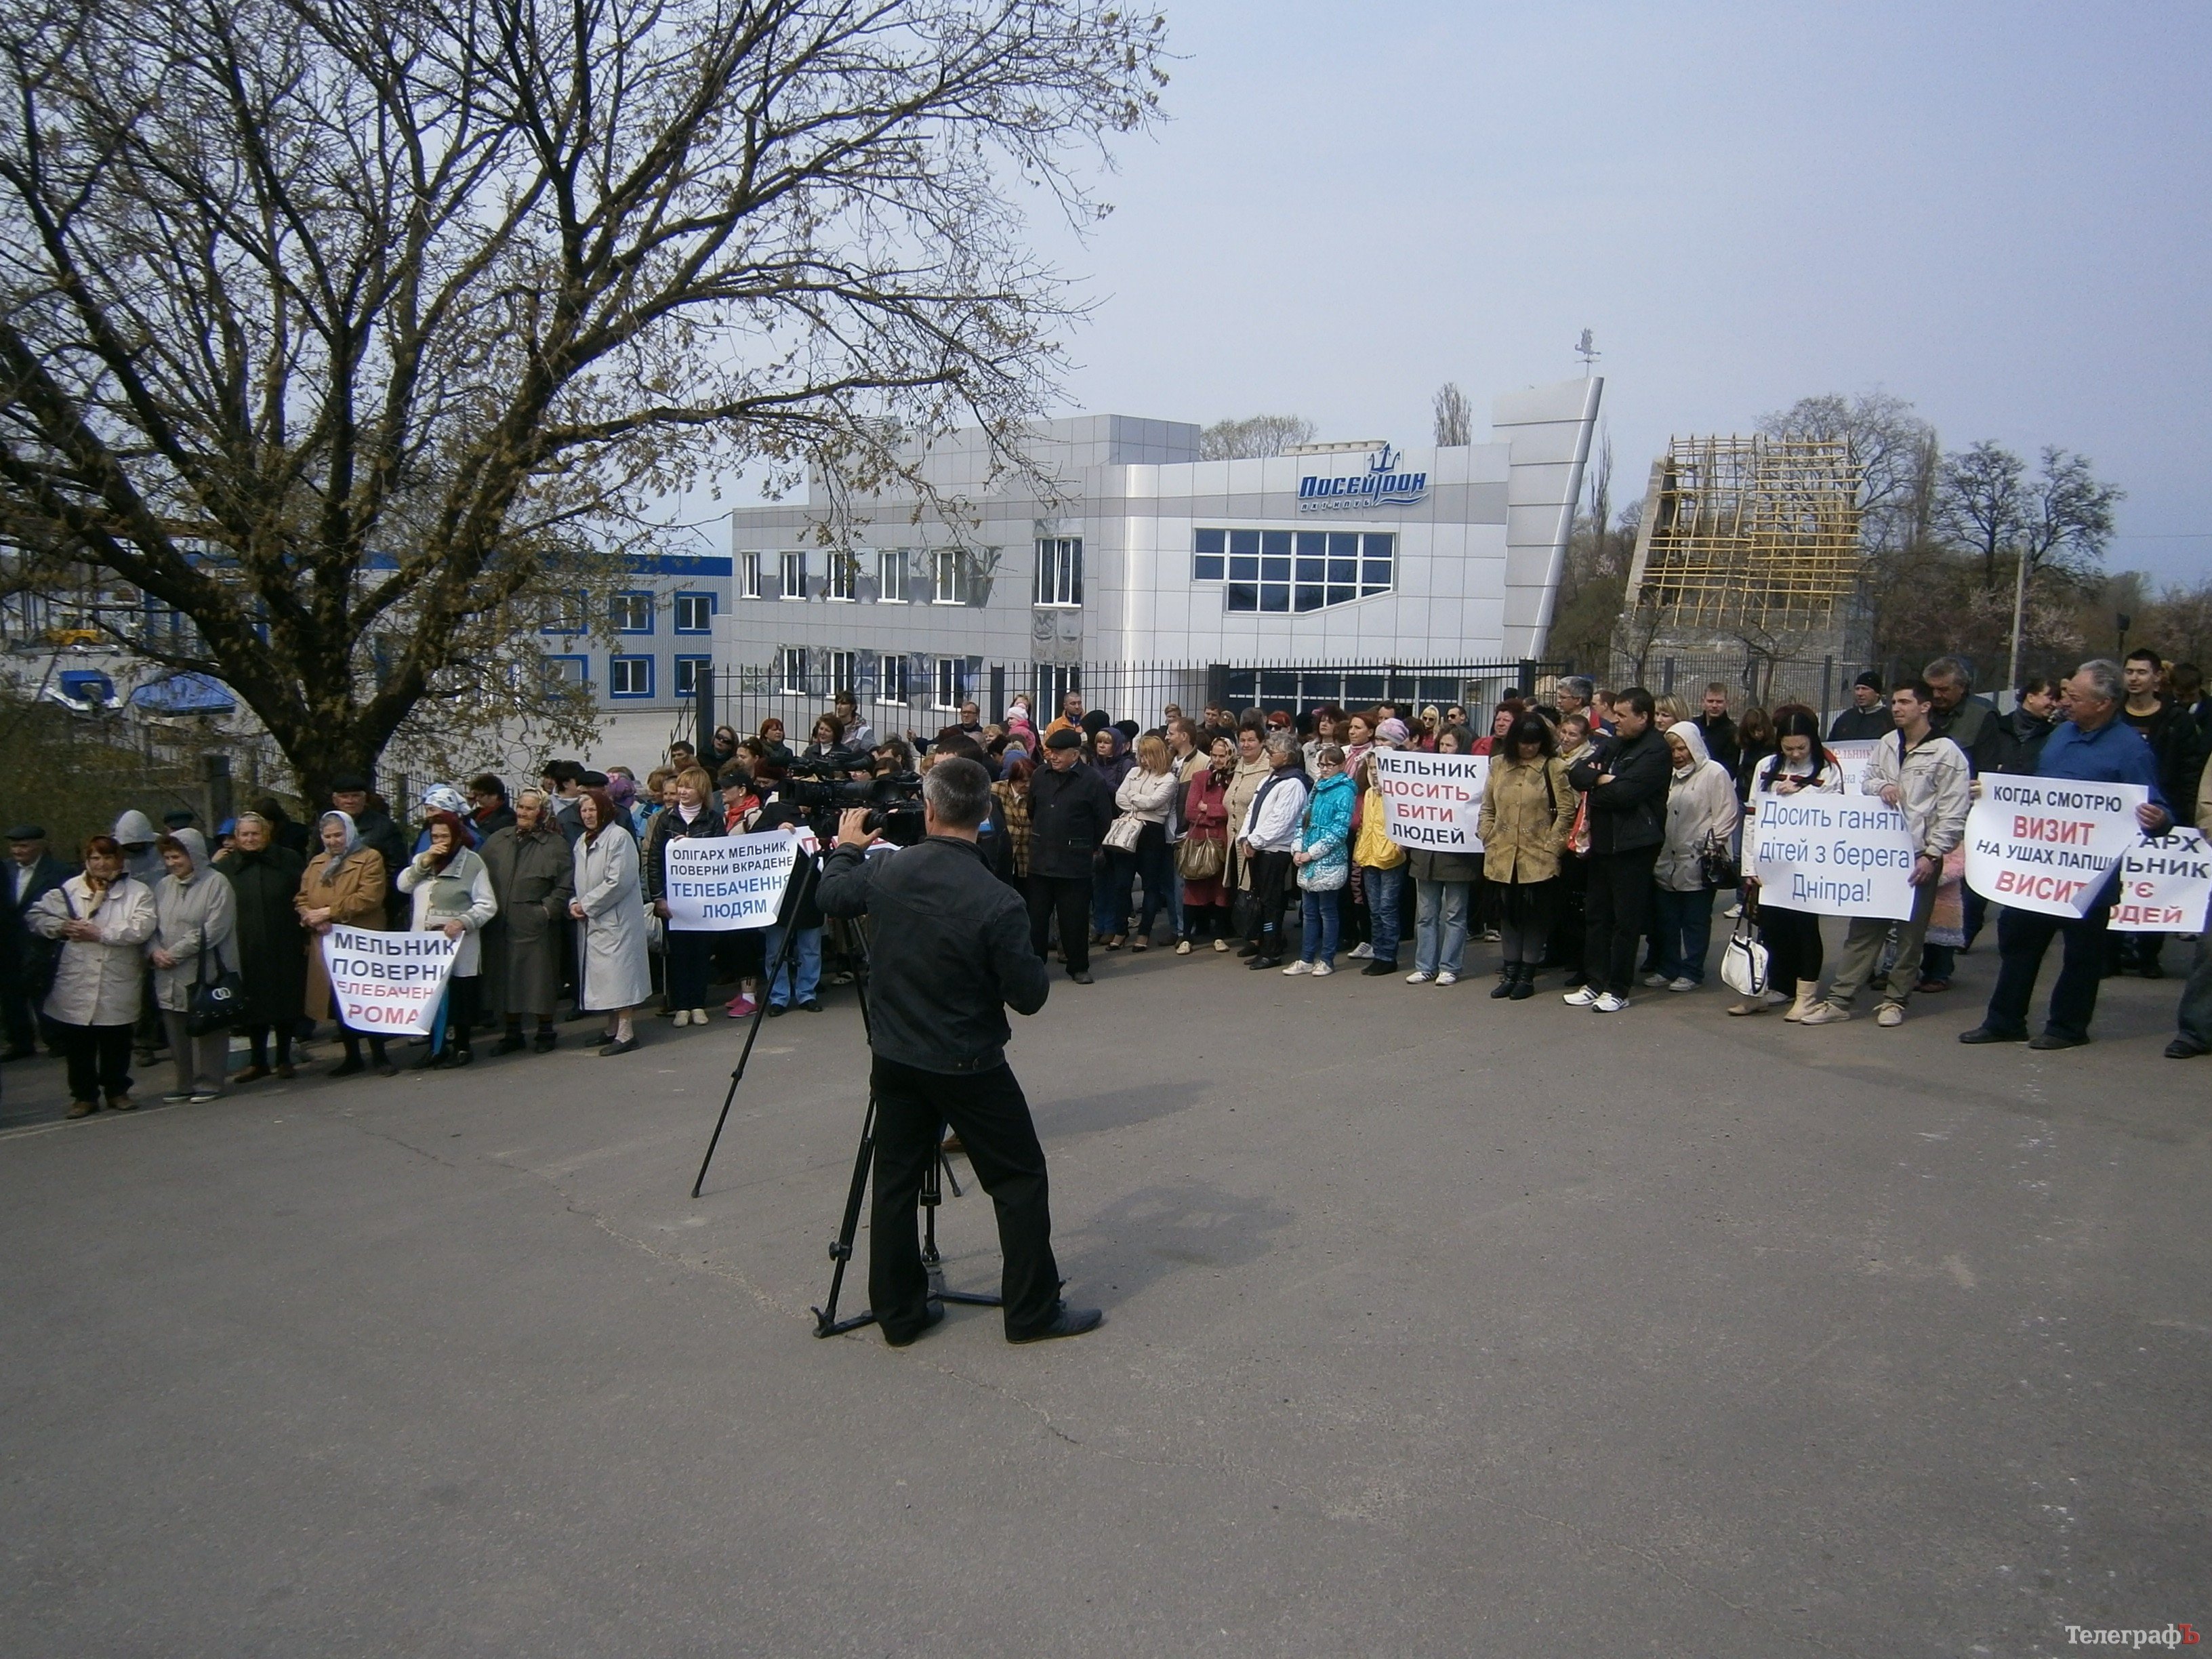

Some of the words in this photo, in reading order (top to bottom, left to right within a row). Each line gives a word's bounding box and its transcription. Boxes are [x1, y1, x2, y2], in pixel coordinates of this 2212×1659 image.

[1377, 757, 1477, 778] МЕЛЬНИК
[1382, 780, 1470, 801] ДОСИТЬ
[1994, 785, 2041, 806] КОГДА
[2047, 791, 2122, 813] СМОТРЮ
[1397, 803, 1453, 823] БИТИ
[1761, 800, 1832, 829] Досить
[1392, 823, 1465, 844] ЛЮДЕЙ
[2013, 815, 2095, 846] ВИЗИТ
[672, 849, 725, 861] ОЛІГАРХ
[729, 841, 790, 859] МЕЛЬНИК,
[1976, 839, 2000, 857] НА
[2007, 844, 2054, 865] УШАХ
[2136, 832, 2200, 853] АРХ
[1759, 836, 1808, 863] дітей
[1815, 844, 1826, 863] з
[1834, 840, 1910, 872] берега
[671, 864, 729, 876] ПОВЕРНИ
[733, 856, 793, 873] ВКРАДЕНЕ
[1793, 874, 1871, 906] Дніпра!
[703, 899, 767, 919] ЛЮДЯМ
[335, 933, 455, 956] МЕЛЬНИК
[336, 981, 434, 999] ЕЛЕБАЧЕН
[348, 1004, 419, 1025] РОМА
